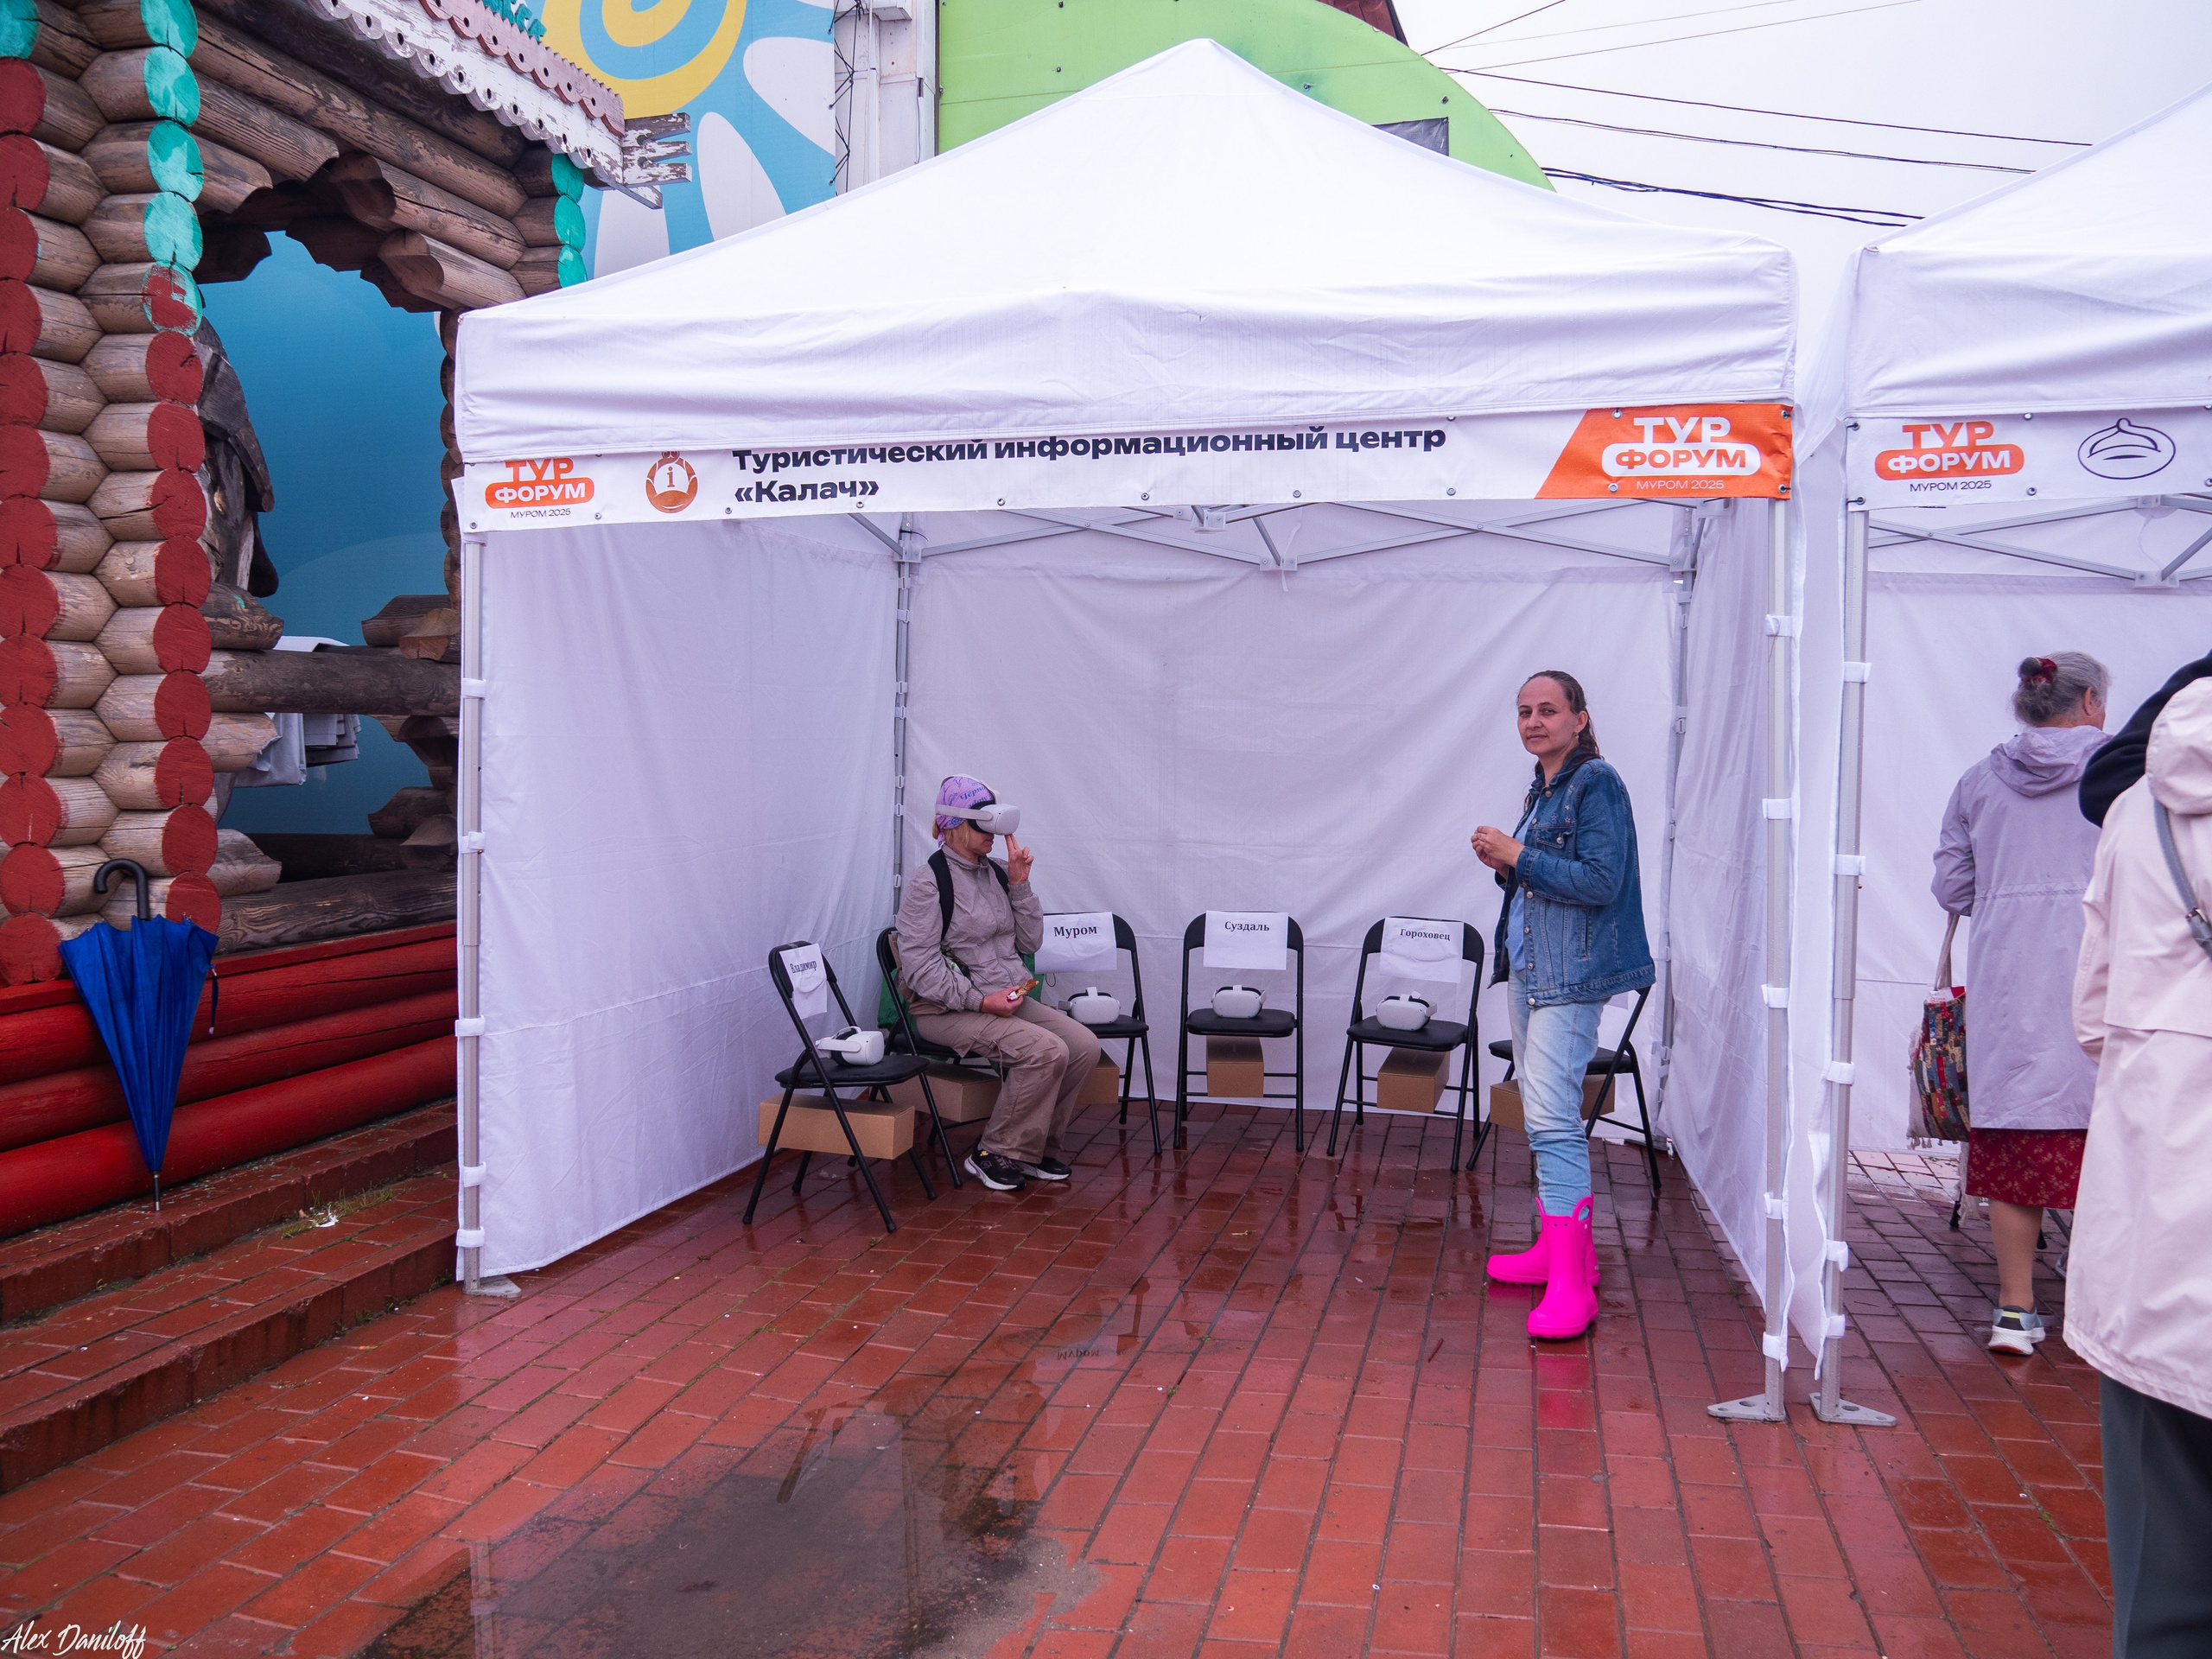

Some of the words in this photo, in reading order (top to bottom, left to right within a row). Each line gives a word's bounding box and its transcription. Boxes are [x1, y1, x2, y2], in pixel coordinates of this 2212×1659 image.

[1633, 416, 1731, 443] ТУР
[1902, 420, 1994, 450] ТУР
[732, 439, 988, 474] Туристический
[995, 426, 1328, 461] информационный
[1336, 429, 1446, 453] центр
[1615, 448, 1746, 470] ФОРУМ
[505, 457, 574, 482] ТУР
[1887, 449, 2011, 474] ФОРУМ
[494, 482, 586, 504] ФОРУМ
[734, 480, 880, 503] «Калач»
[1636, 480, 1689, 490] МУРОМ
[1690, 480, 1725, 490] 2025
[1910, 481, 1958, 493] МУРОМ
[1960, 480, 1992, 491] 2025
[510, 510, 547, 518] МУРОМ
[548, 508, 571, 517] 2025
[1053, 925, 1097, 938] Муром
[1224, 920, 1270, 933] Суздаль
[1400, 927, 1451, 942] Гороховец
[790, 960, 817, 974] Владимир
